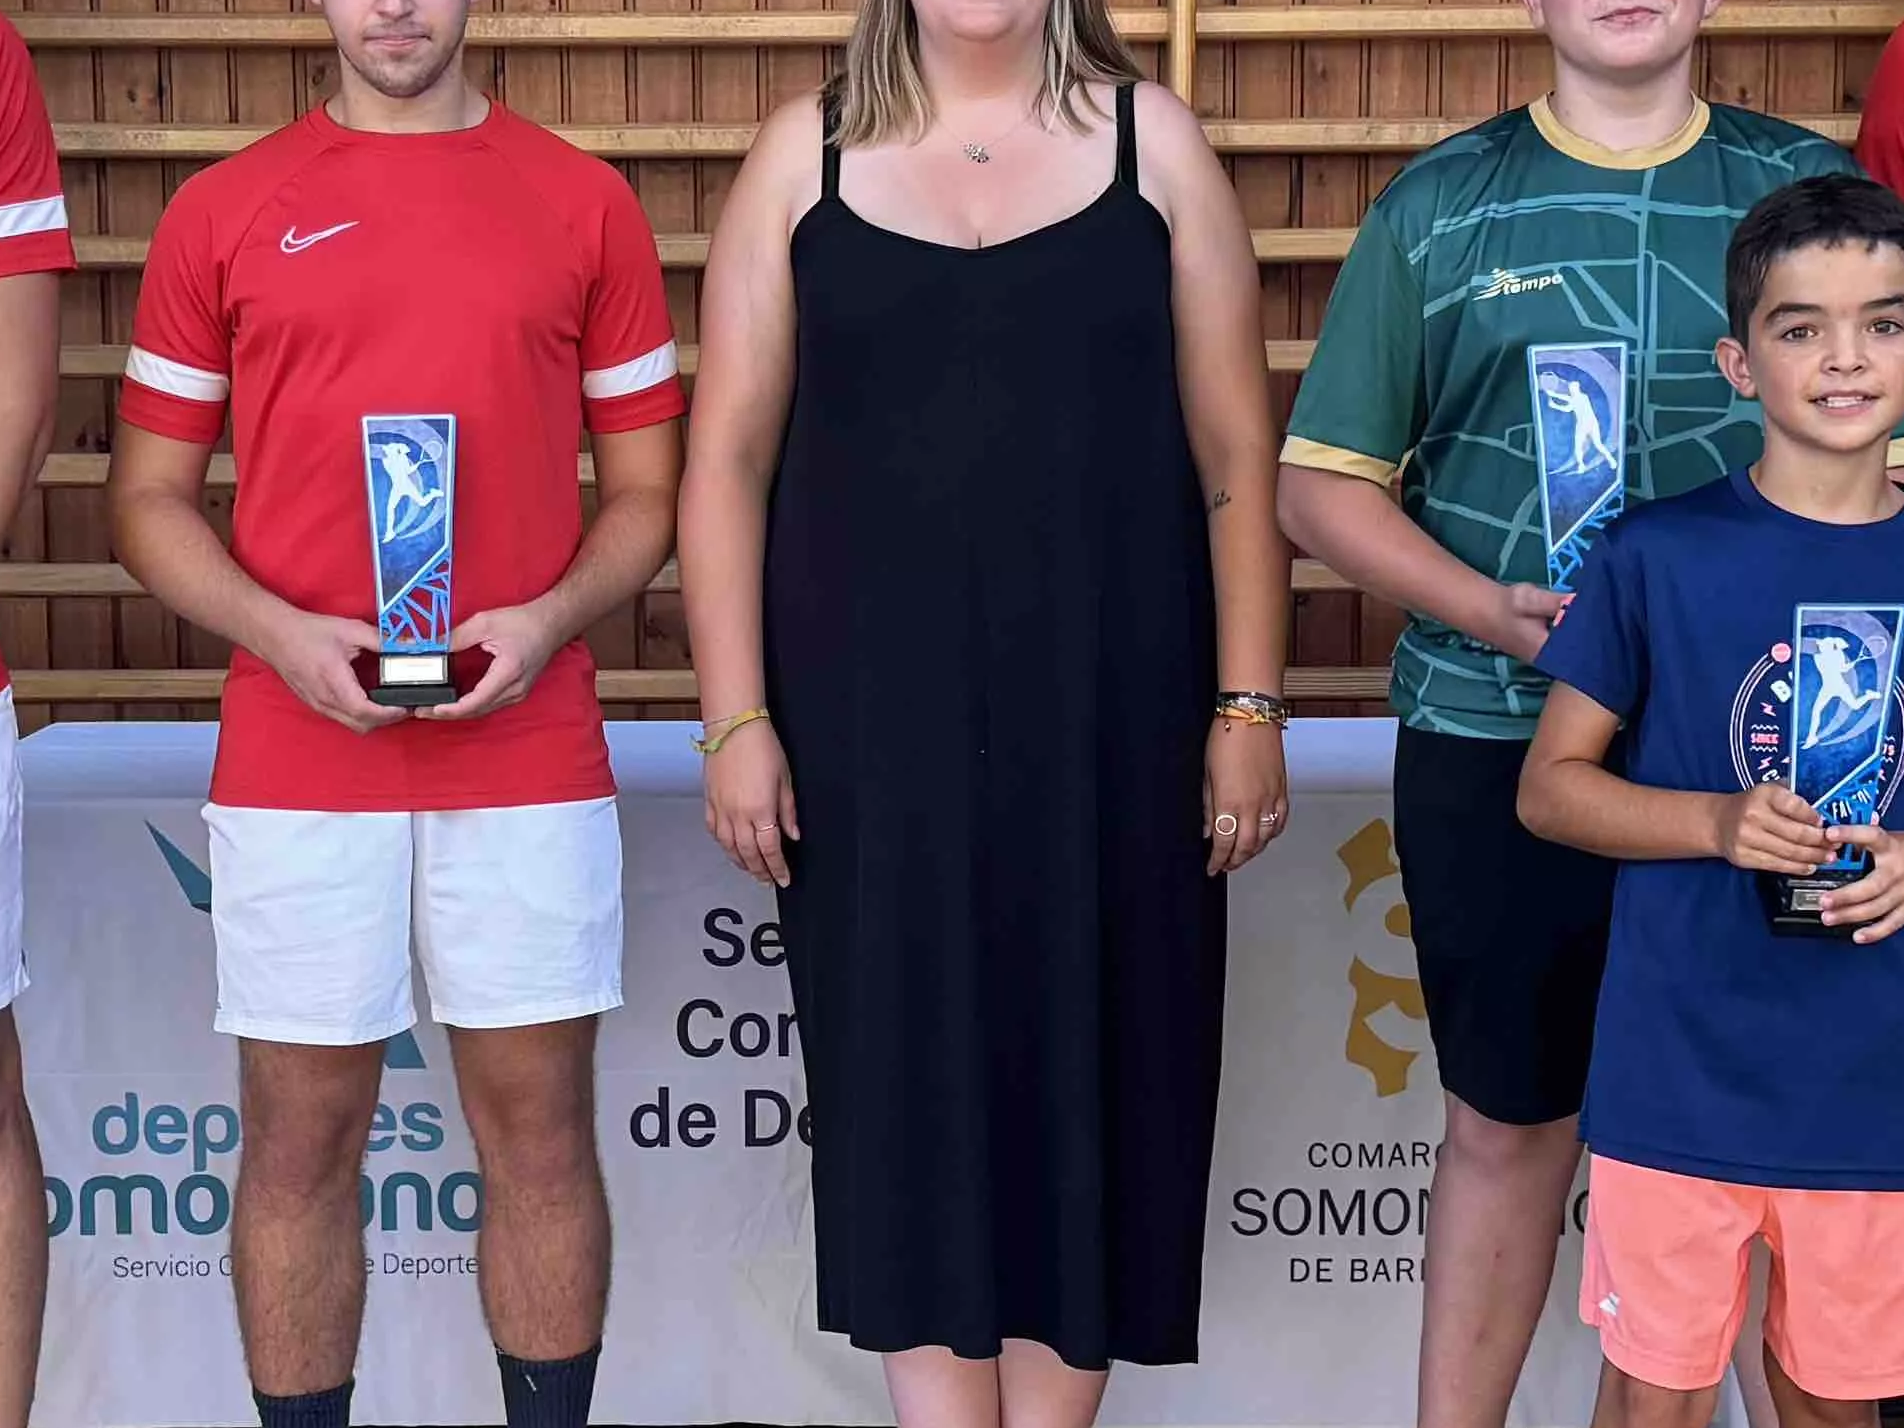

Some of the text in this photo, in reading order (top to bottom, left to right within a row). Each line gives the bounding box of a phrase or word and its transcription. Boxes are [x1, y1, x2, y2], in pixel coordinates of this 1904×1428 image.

[630, 1087, 716, 1148] de
[1307, 1142, 1443, 1169] COMAR
[112, 1254, 211, 1278] Servicio
[383, 1253, 479, 1280] Deporte
[1290, 1258, 1334, 1283] DE
